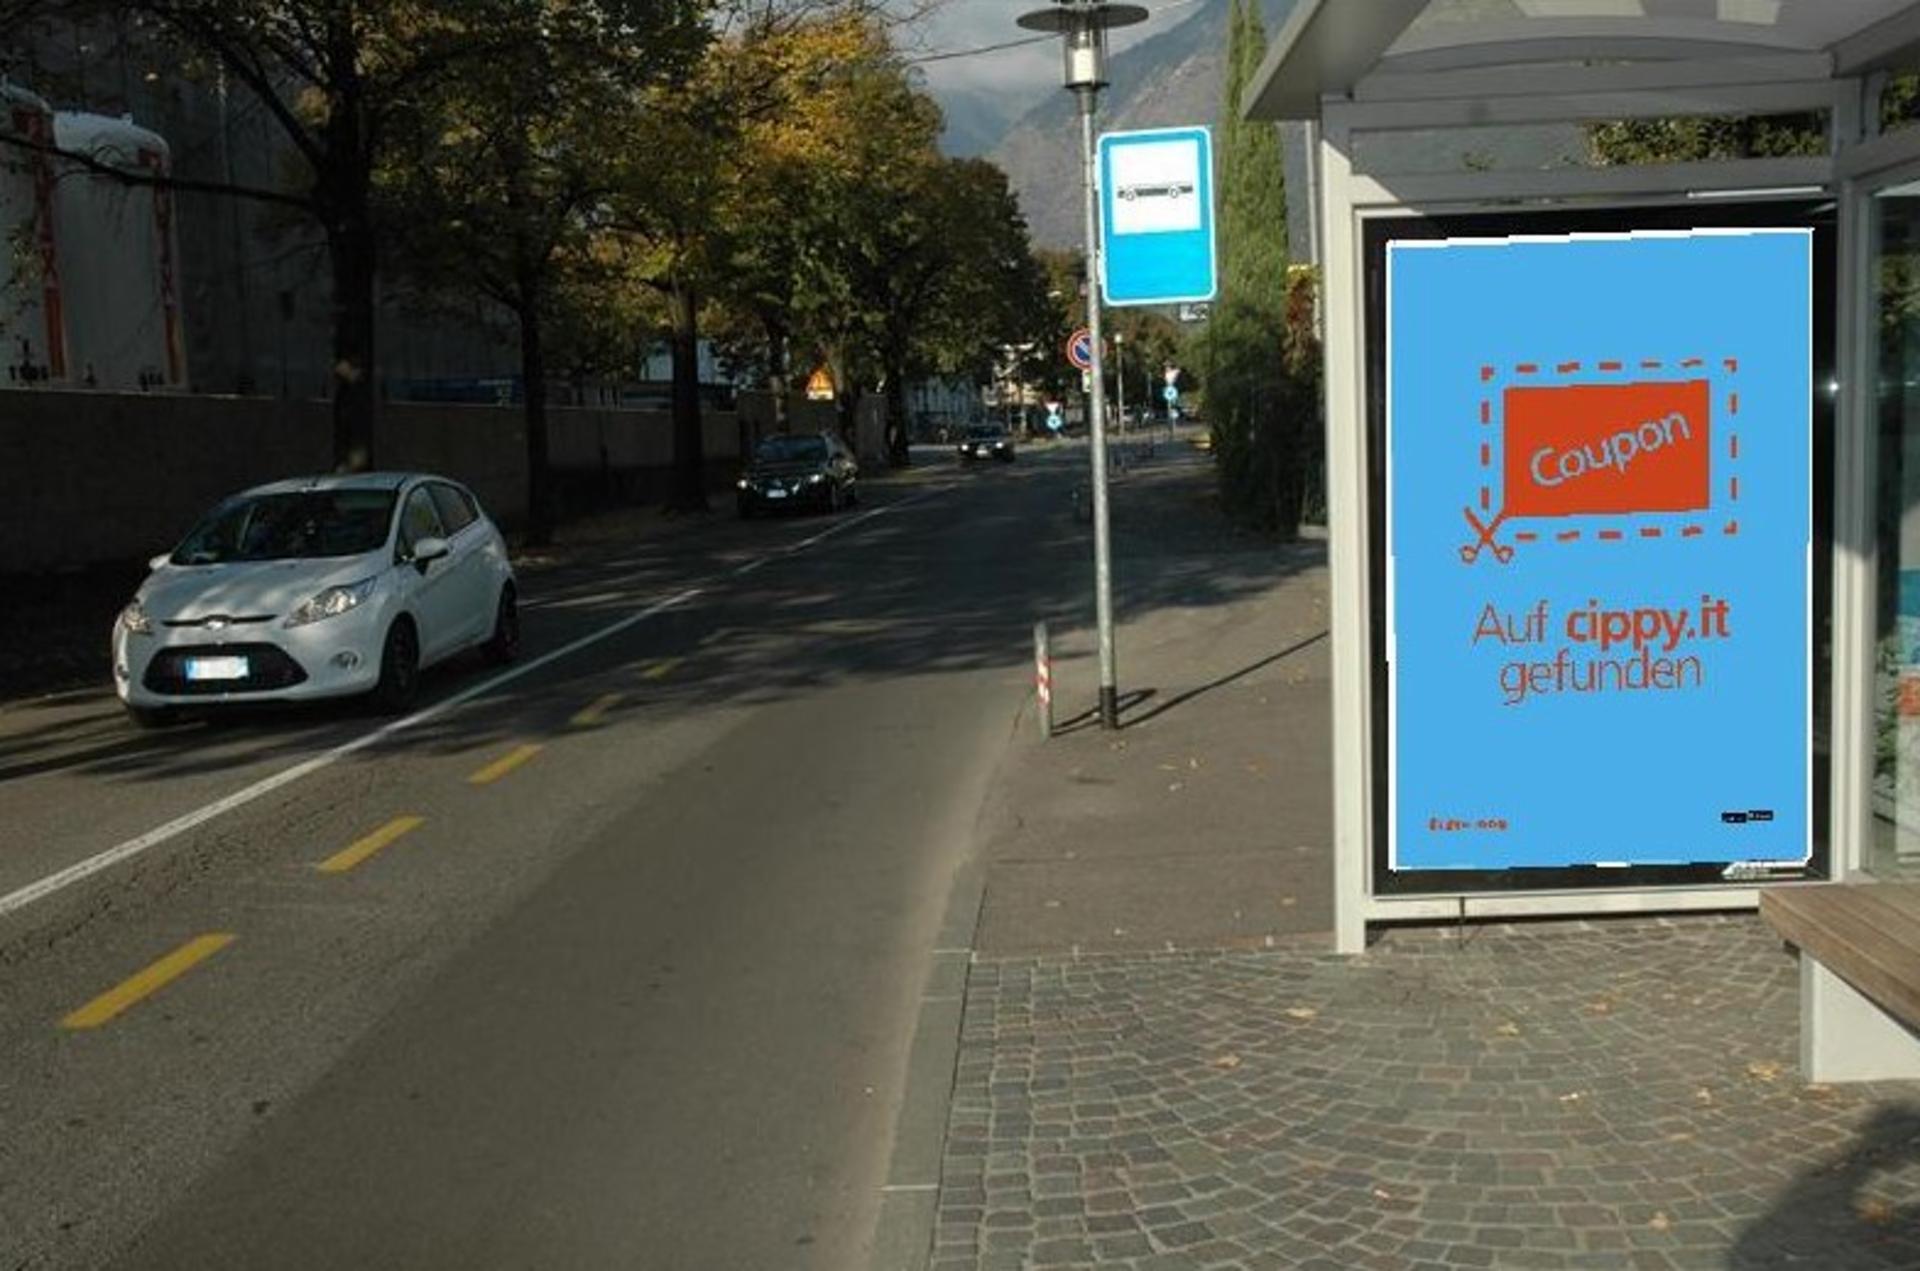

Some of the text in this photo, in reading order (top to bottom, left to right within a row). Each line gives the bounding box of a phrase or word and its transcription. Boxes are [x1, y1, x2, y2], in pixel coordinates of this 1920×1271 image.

[1530, 411, 1691, 488] Coupon
[1472, 595, 1731, 651] Auf cippy.it
[1499, 647, 1701, 706] gefunden
